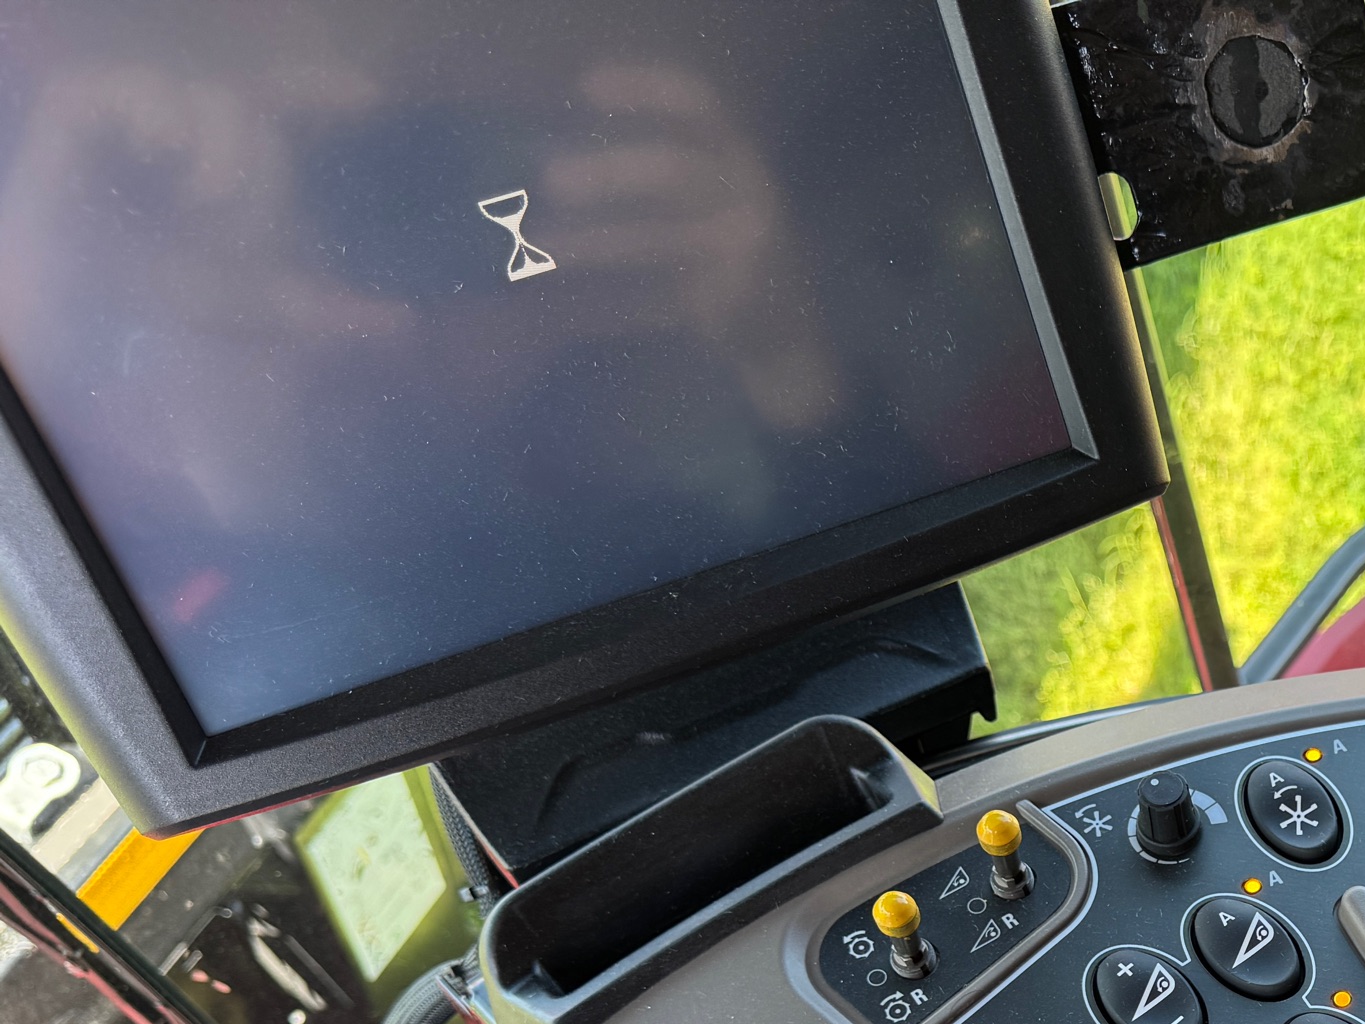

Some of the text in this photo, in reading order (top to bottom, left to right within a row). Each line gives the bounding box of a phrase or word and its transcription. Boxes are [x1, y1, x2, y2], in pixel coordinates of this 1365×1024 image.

[1333, 739, 1348, 753] A
[1269, 772, 1285, 787] A
[1269, 871, 1283, 886] A
[1002, 913, 1019, 929] R
[1218, 911, 1235, 926] A
[910, 988, 928, 1005] R
